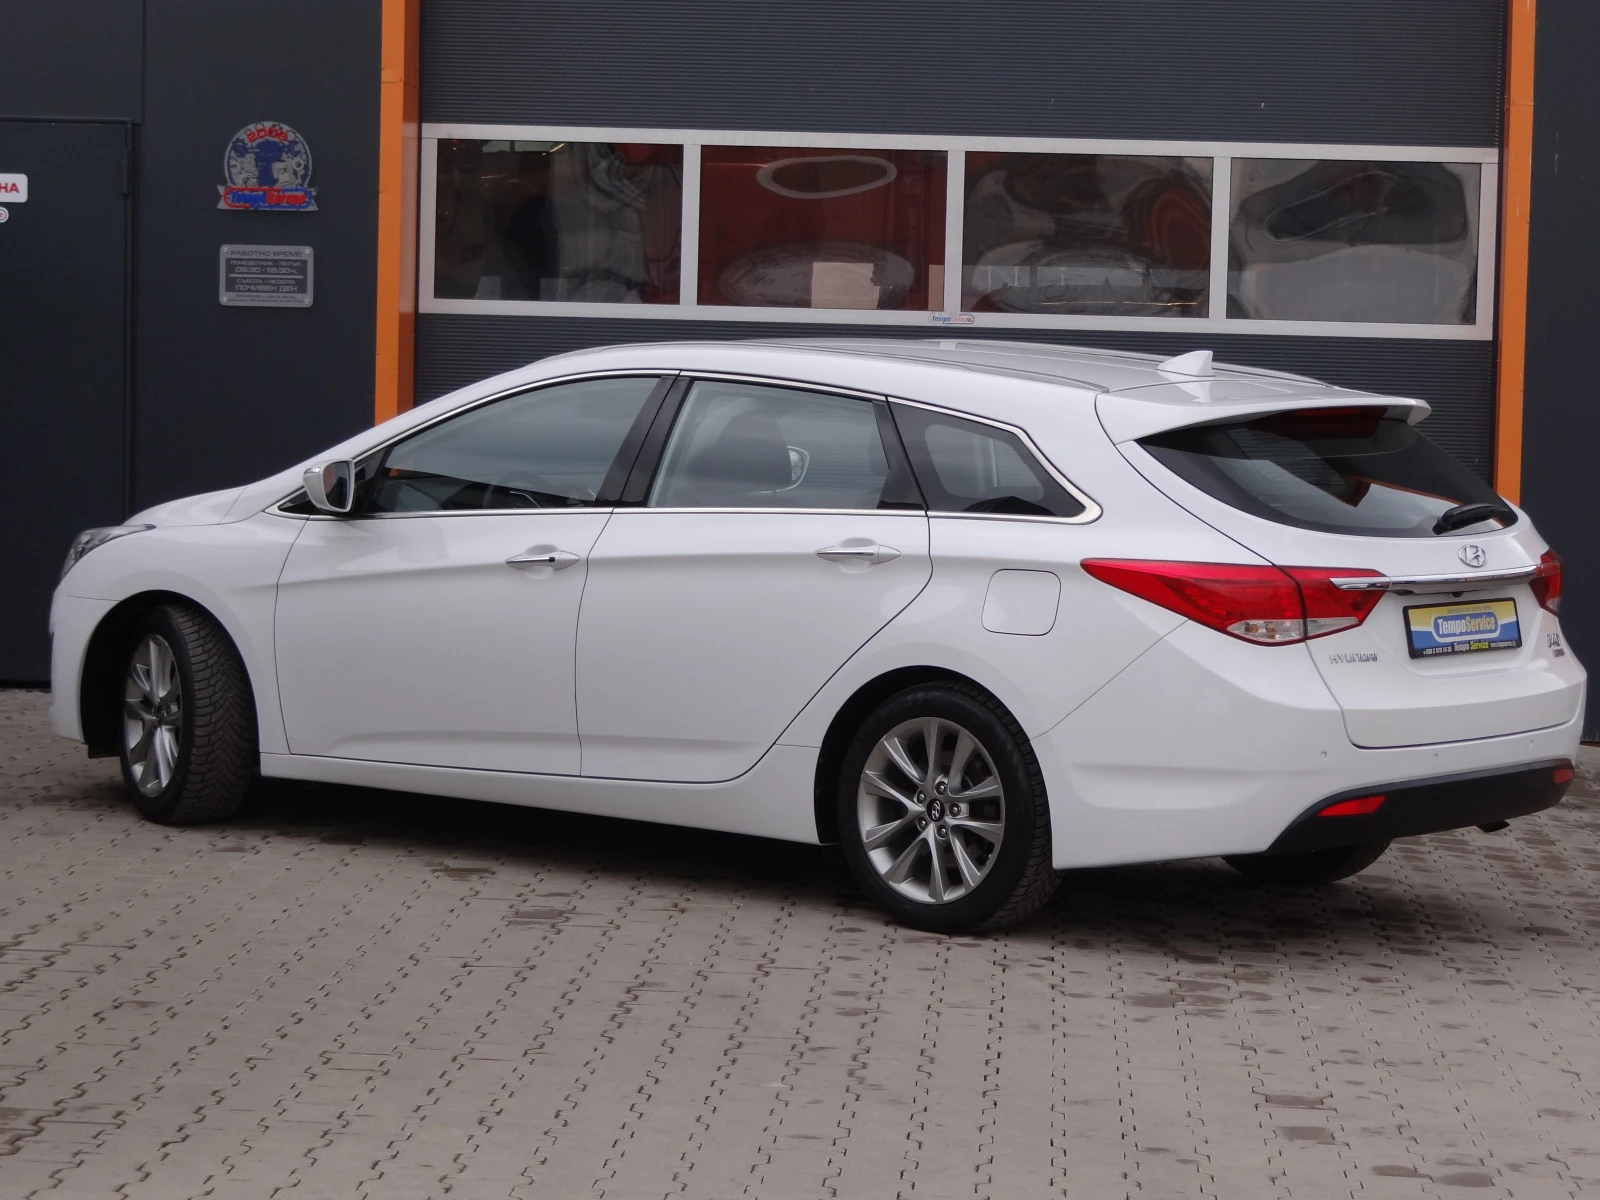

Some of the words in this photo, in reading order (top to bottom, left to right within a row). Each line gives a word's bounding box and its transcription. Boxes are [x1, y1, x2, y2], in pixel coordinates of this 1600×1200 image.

[1437, 615, 1496, 635] TempoService
[1453, 642, 1470, 652] Tempo
[1470, 640, 1489, 650] Service
[1328, 652, 1378, 664] HYUNDAI
